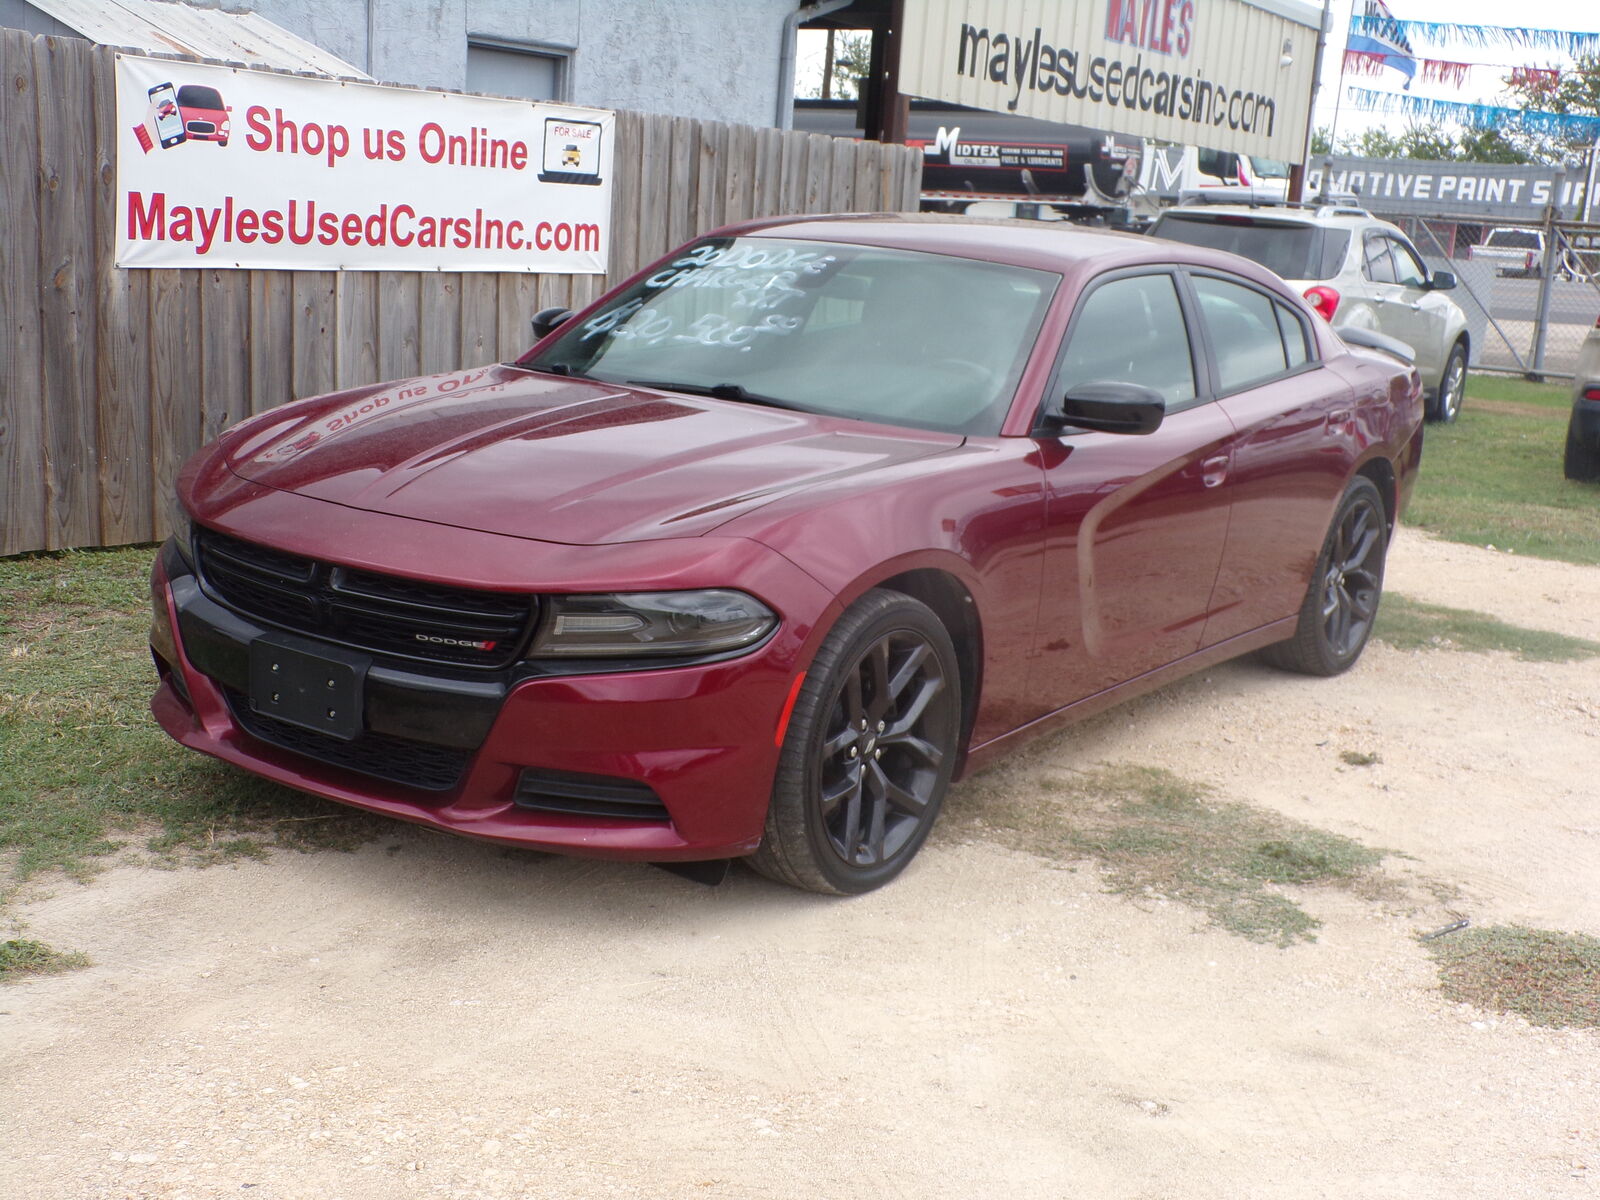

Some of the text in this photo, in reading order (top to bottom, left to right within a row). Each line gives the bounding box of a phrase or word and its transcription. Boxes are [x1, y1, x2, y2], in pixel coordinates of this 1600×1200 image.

[957, 22, 1276, 137] maylesusedcarsinccom
[245, 105, 529, 171] Shop us Online
[554, 126, 592, 139] FOR SALE
[924, 127, 999, 160] MIDTEX
[1437, 175, 1527, 204] PAINT
[127, 190, 600, 256] MaylesUsedCarsInc.com
[415, 633, 487, 650] DODGE
